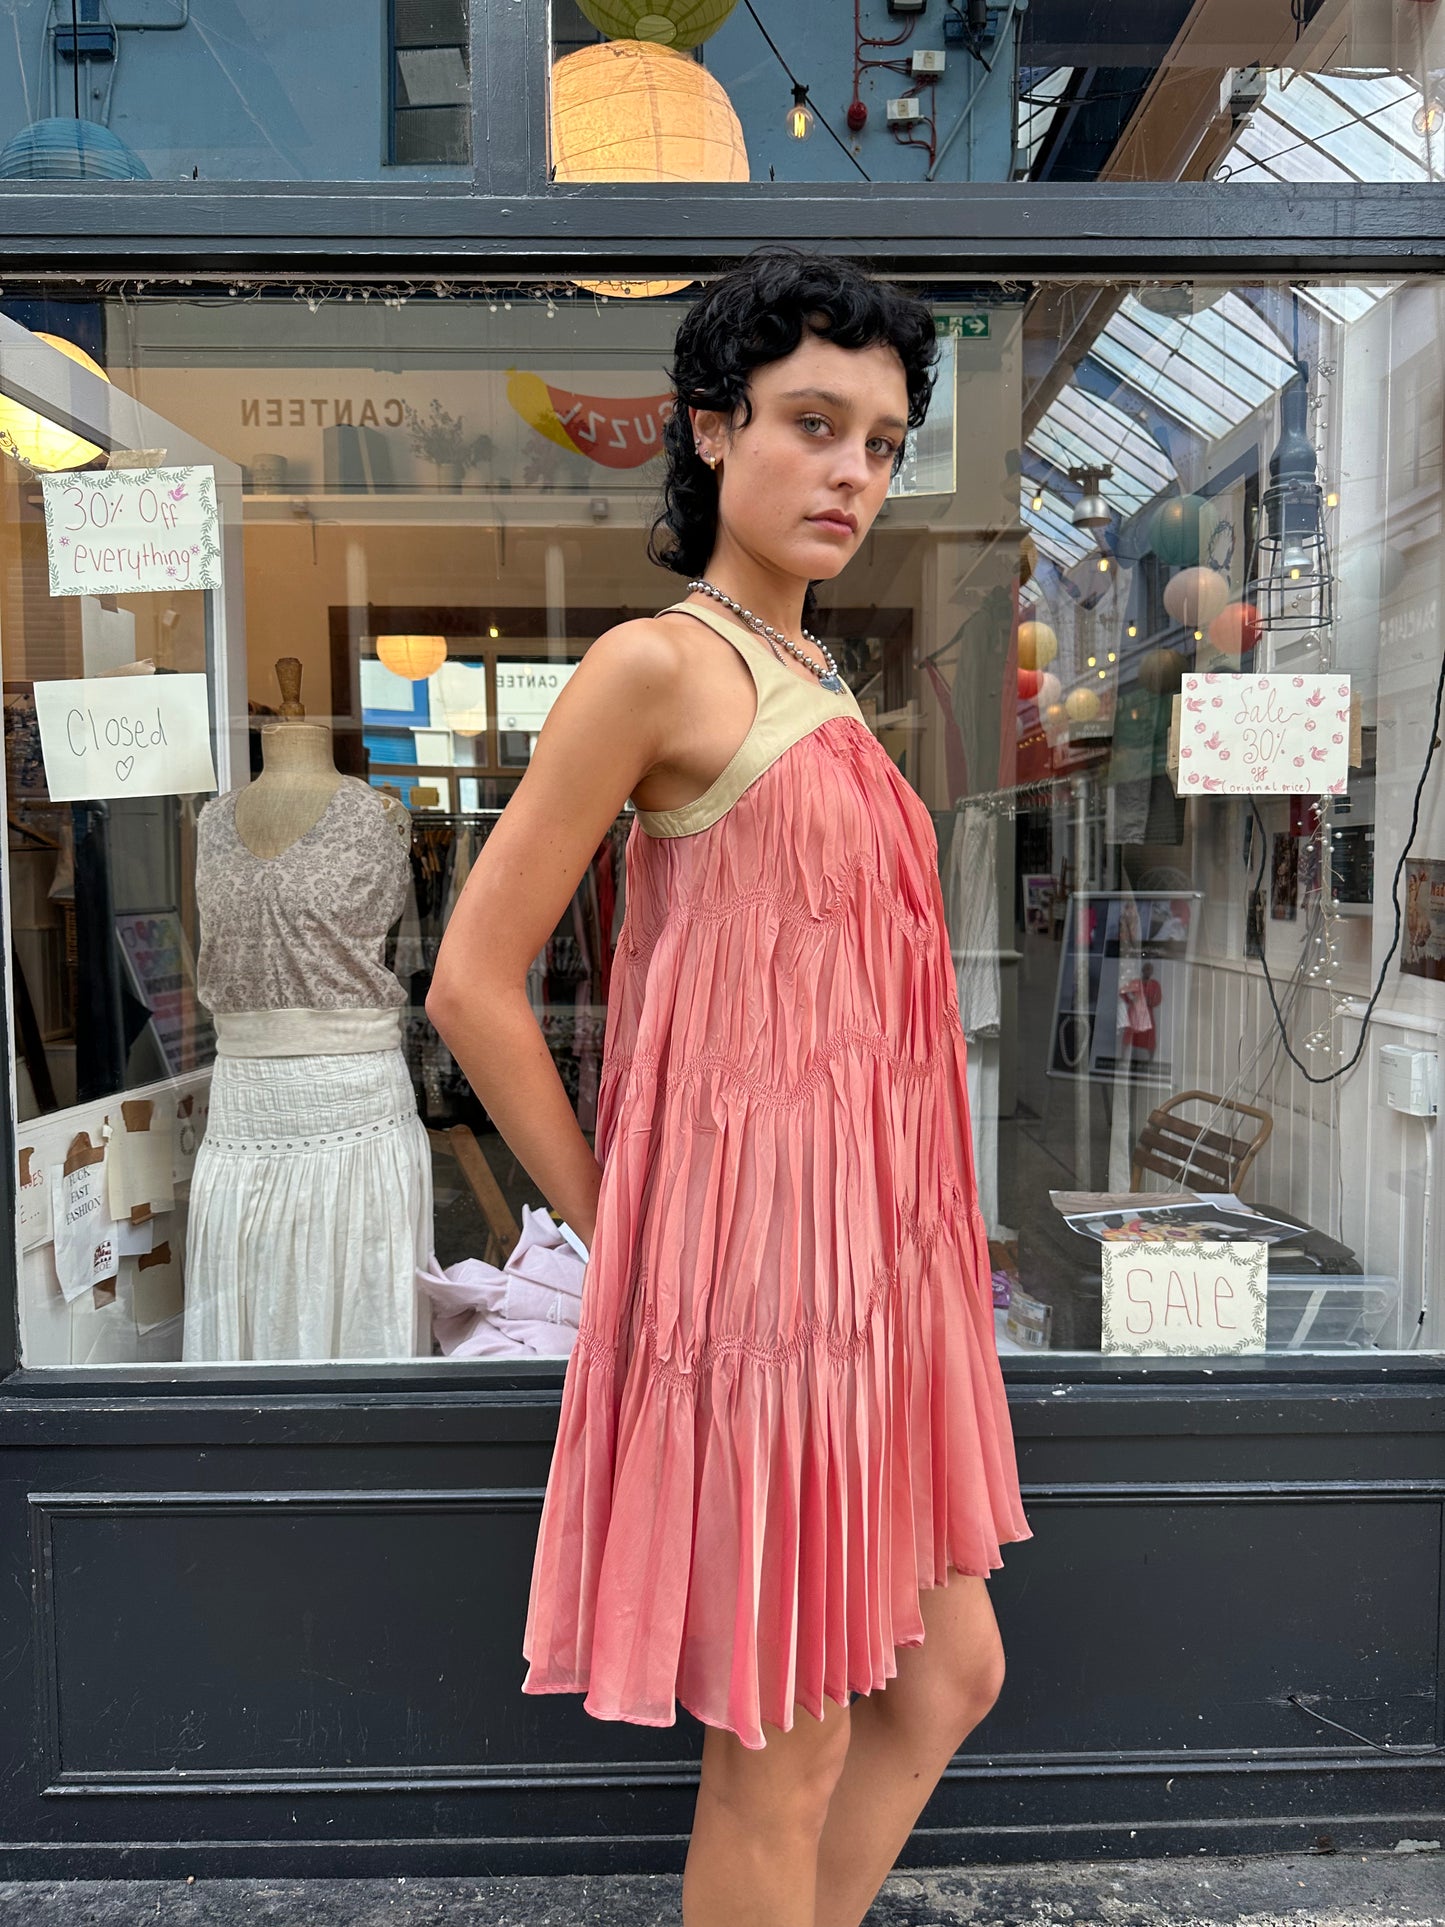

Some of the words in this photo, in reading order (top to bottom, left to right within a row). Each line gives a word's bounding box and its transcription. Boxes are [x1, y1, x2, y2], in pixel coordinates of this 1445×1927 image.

[63, 487, 123, 531] 30%
[139, 488, 179, 530] Off
[74, 542, 190, 582] everything
[1234, 686, 1303, 725] Sale
[67, 707, 168, 757] Closed
[1243, 728, 1286, 764] 30%
[1250, 766, 1269, 783] off
[1281, 777, 1311, 794] price)
[66, 1195, 101, 1226] FASHION
[70, 1183, 90, 1204] FAST
